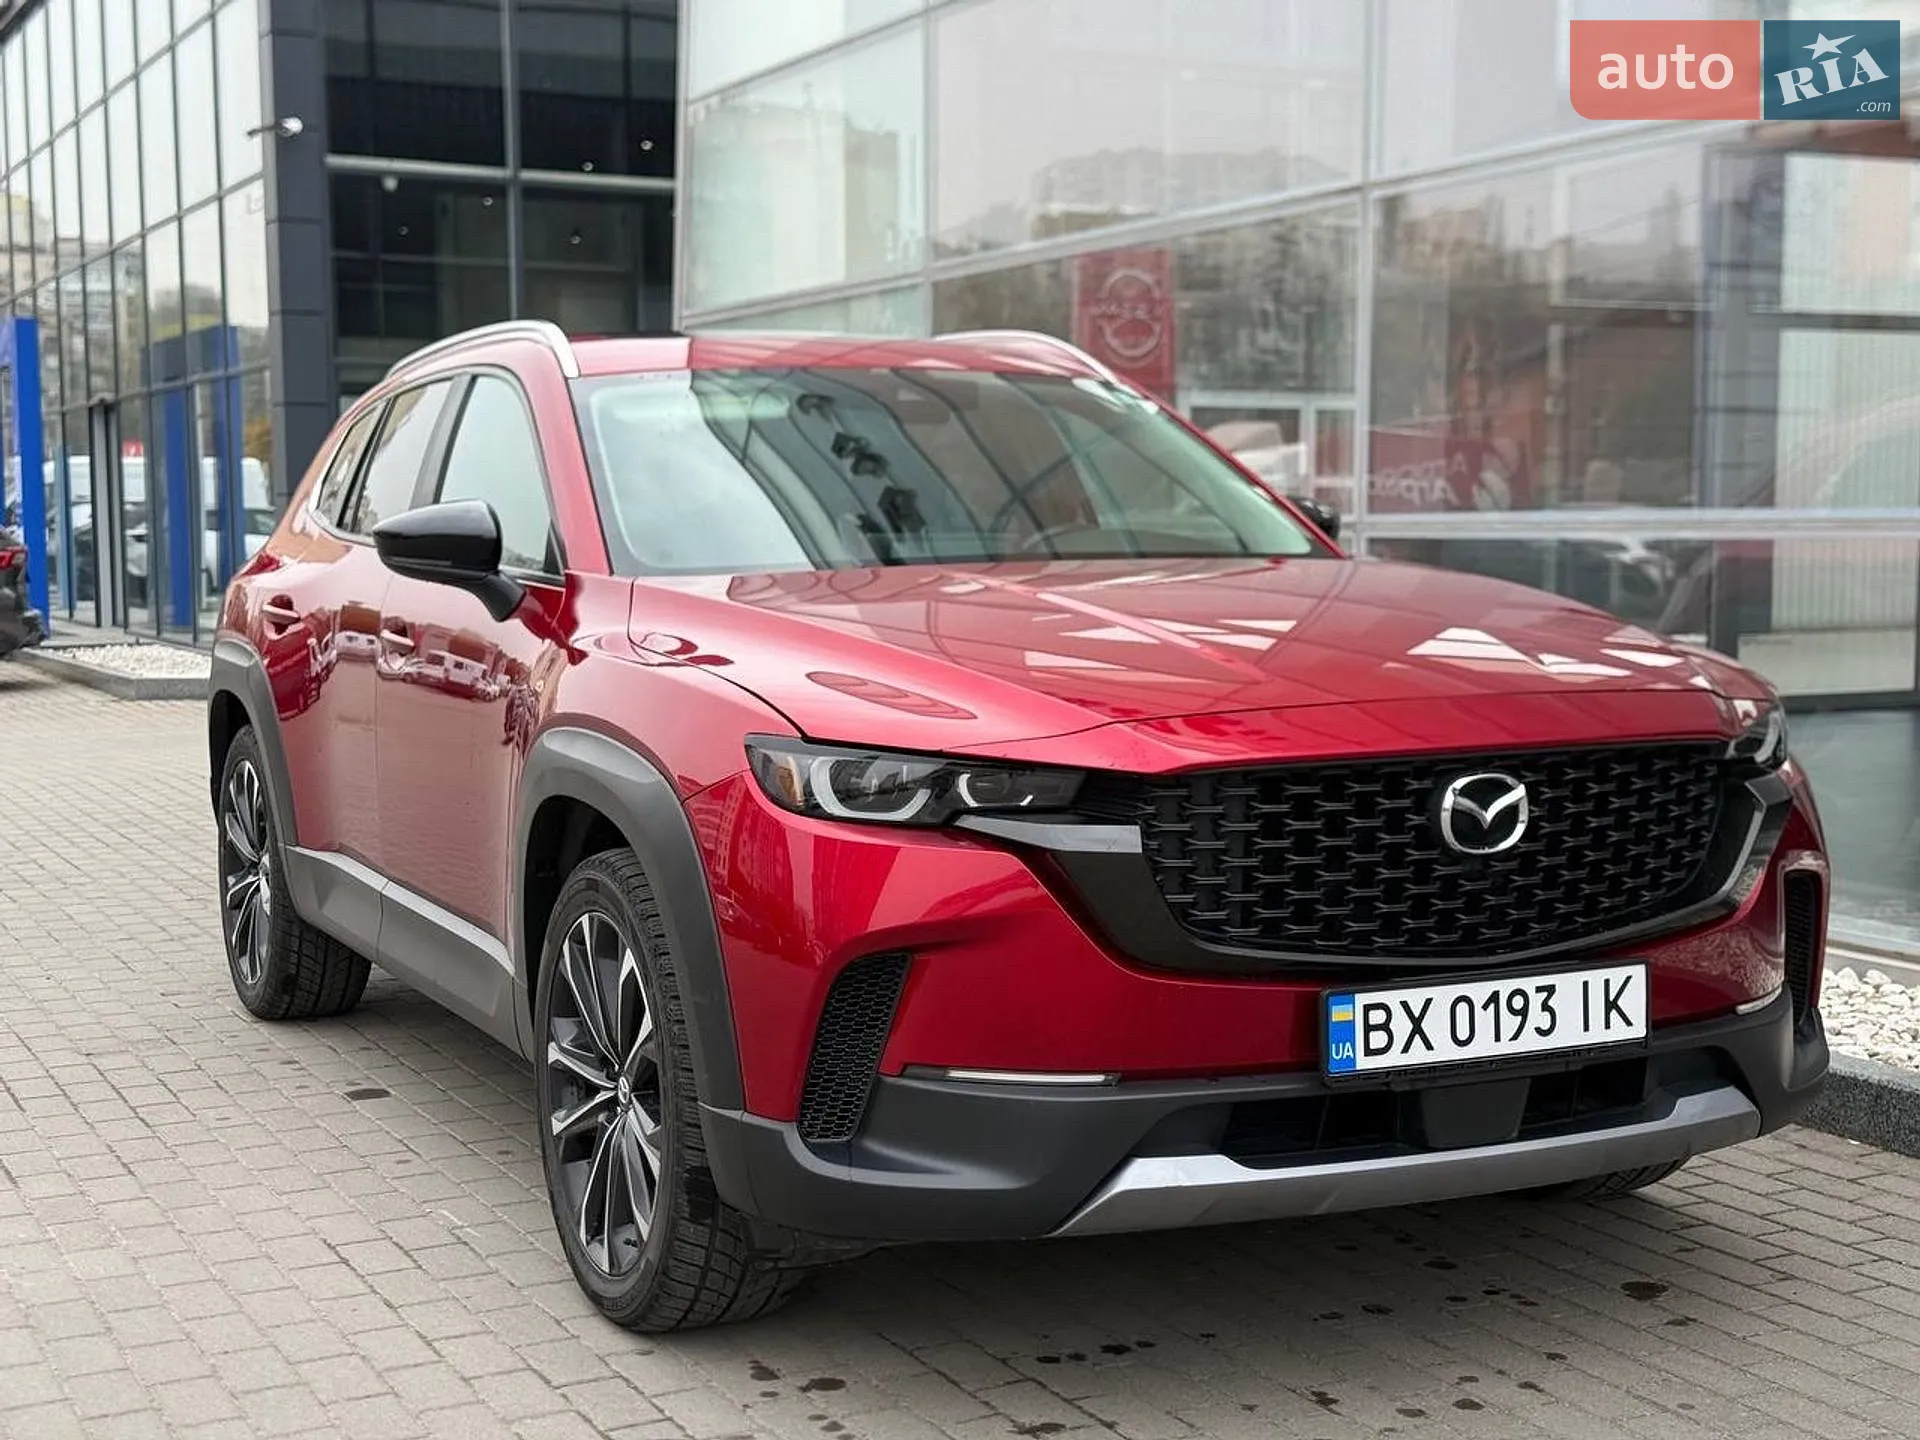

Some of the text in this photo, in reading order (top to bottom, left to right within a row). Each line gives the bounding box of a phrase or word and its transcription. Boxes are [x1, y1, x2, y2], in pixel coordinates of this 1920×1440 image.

[1363, 975, 1633, 1057] BX 0193 IK
[1332, 1041, 1354, 1060] UA
